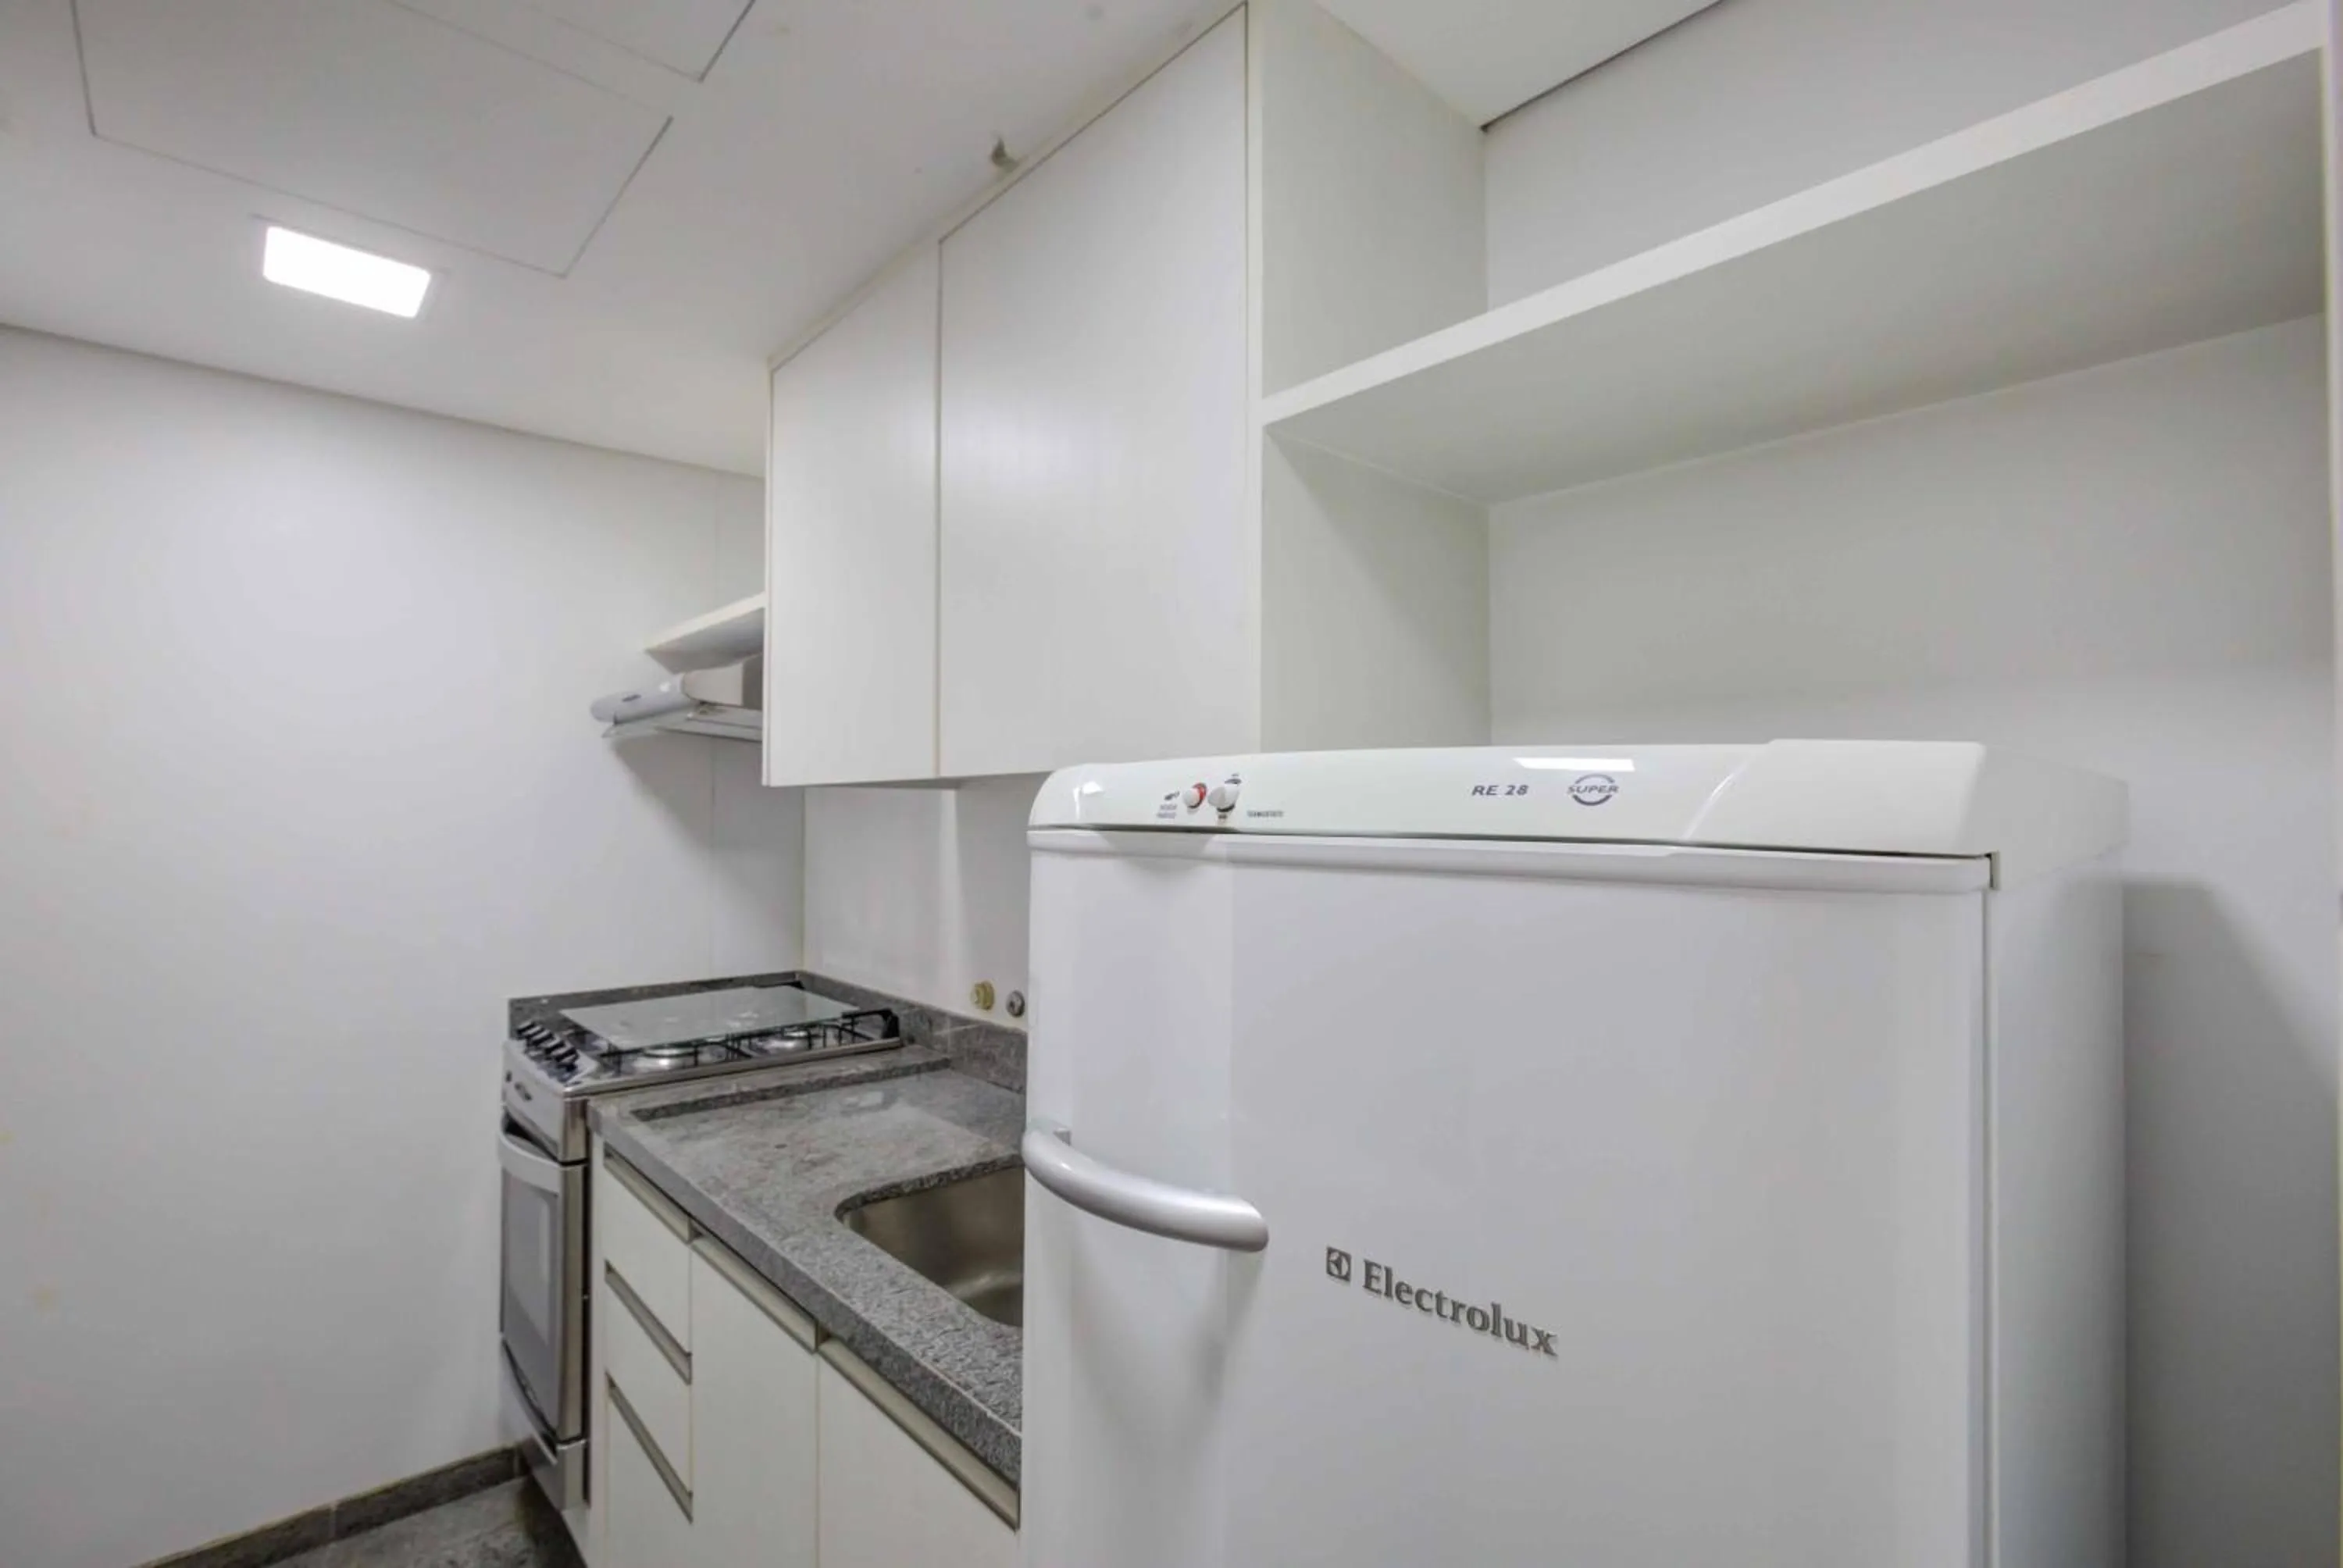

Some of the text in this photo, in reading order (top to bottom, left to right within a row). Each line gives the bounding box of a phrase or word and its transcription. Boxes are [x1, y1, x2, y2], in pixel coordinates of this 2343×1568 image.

[1471, 784, 1529, 796] RE 28
[1567, 784, 1620, 794] SUPER
[1363, 1258, 1558, 1356] Electrolux
